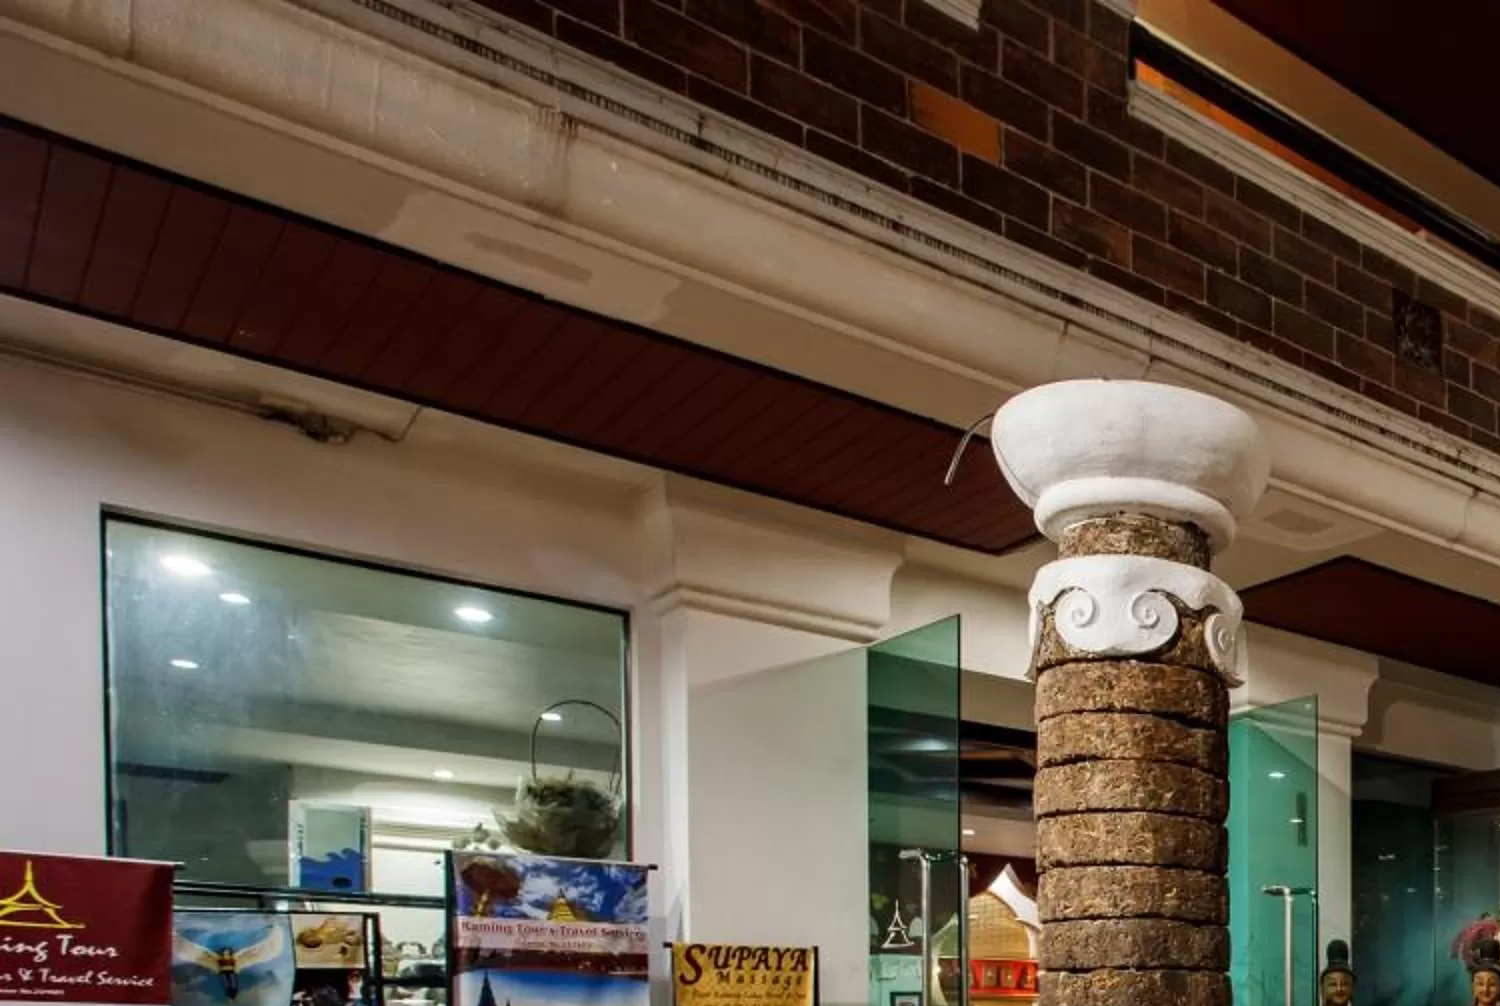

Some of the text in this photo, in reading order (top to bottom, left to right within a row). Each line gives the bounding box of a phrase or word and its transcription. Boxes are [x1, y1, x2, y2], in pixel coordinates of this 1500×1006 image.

[37, 968, 94, 984] Travel
[96, 970, 155, 987] Service
[679, 943, 809, 985] SUPAYA
